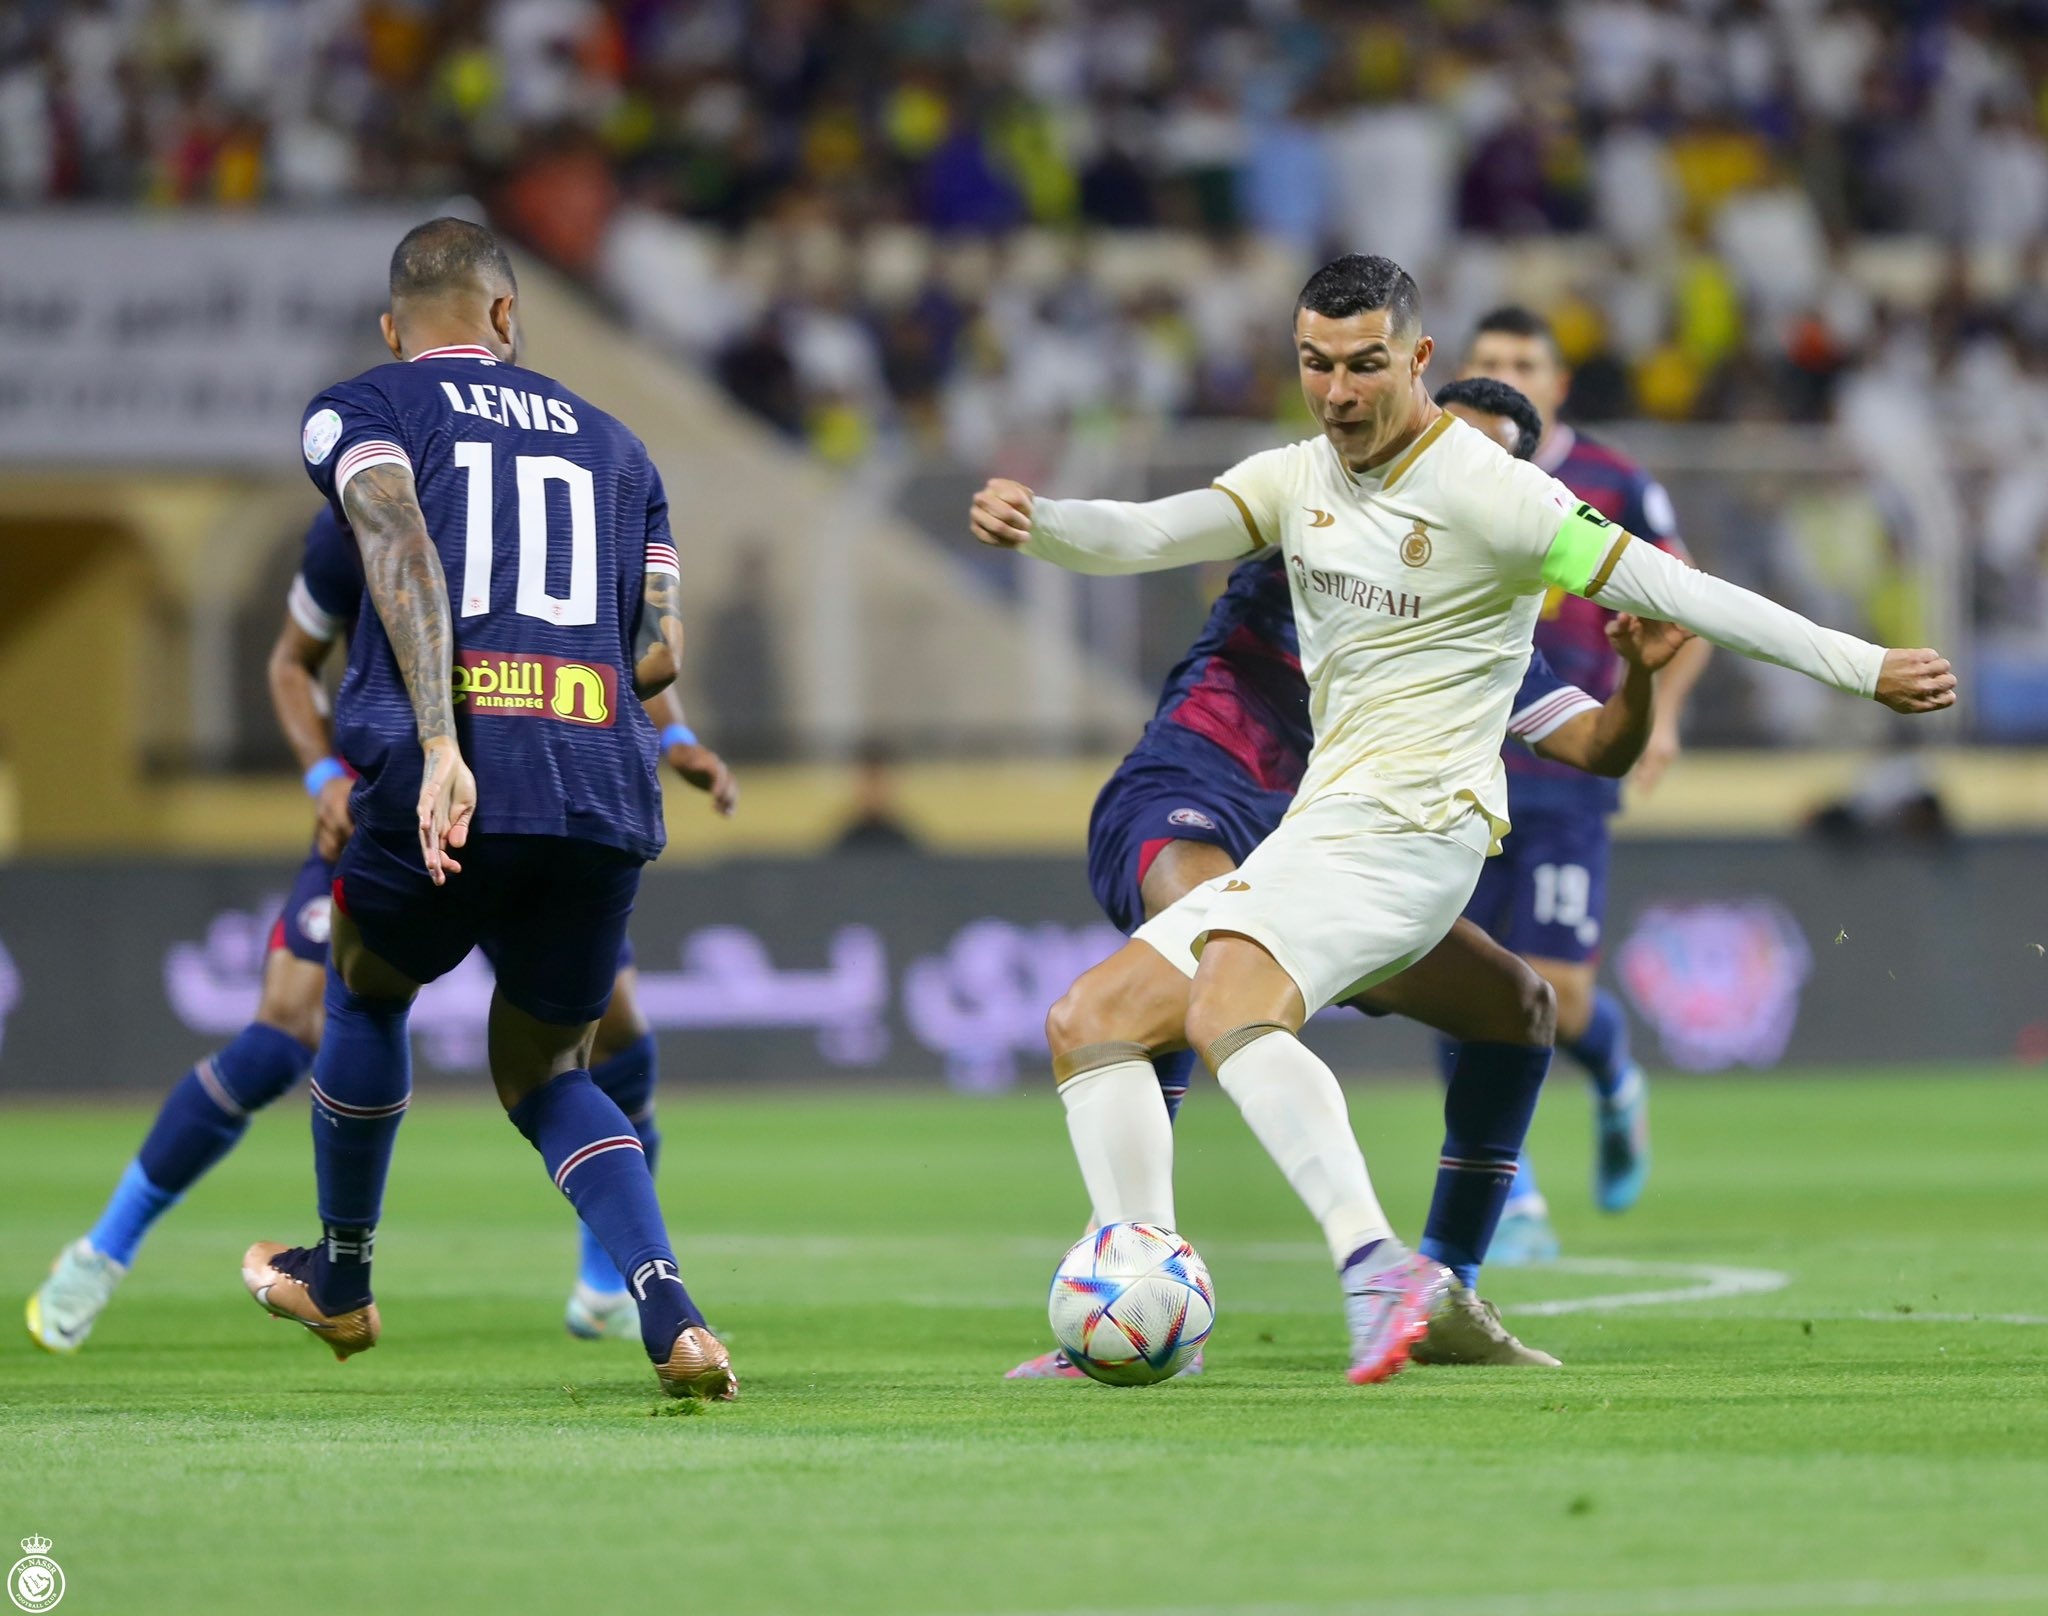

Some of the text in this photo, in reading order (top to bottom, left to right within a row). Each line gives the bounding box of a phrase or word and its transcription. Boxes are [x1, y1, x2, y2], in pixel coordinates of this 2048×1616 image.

[440, 381, 579, 434] LENIS
[454, 441, 597, 626] 10
[1310, 569, 1422, 619] SHURFAH
